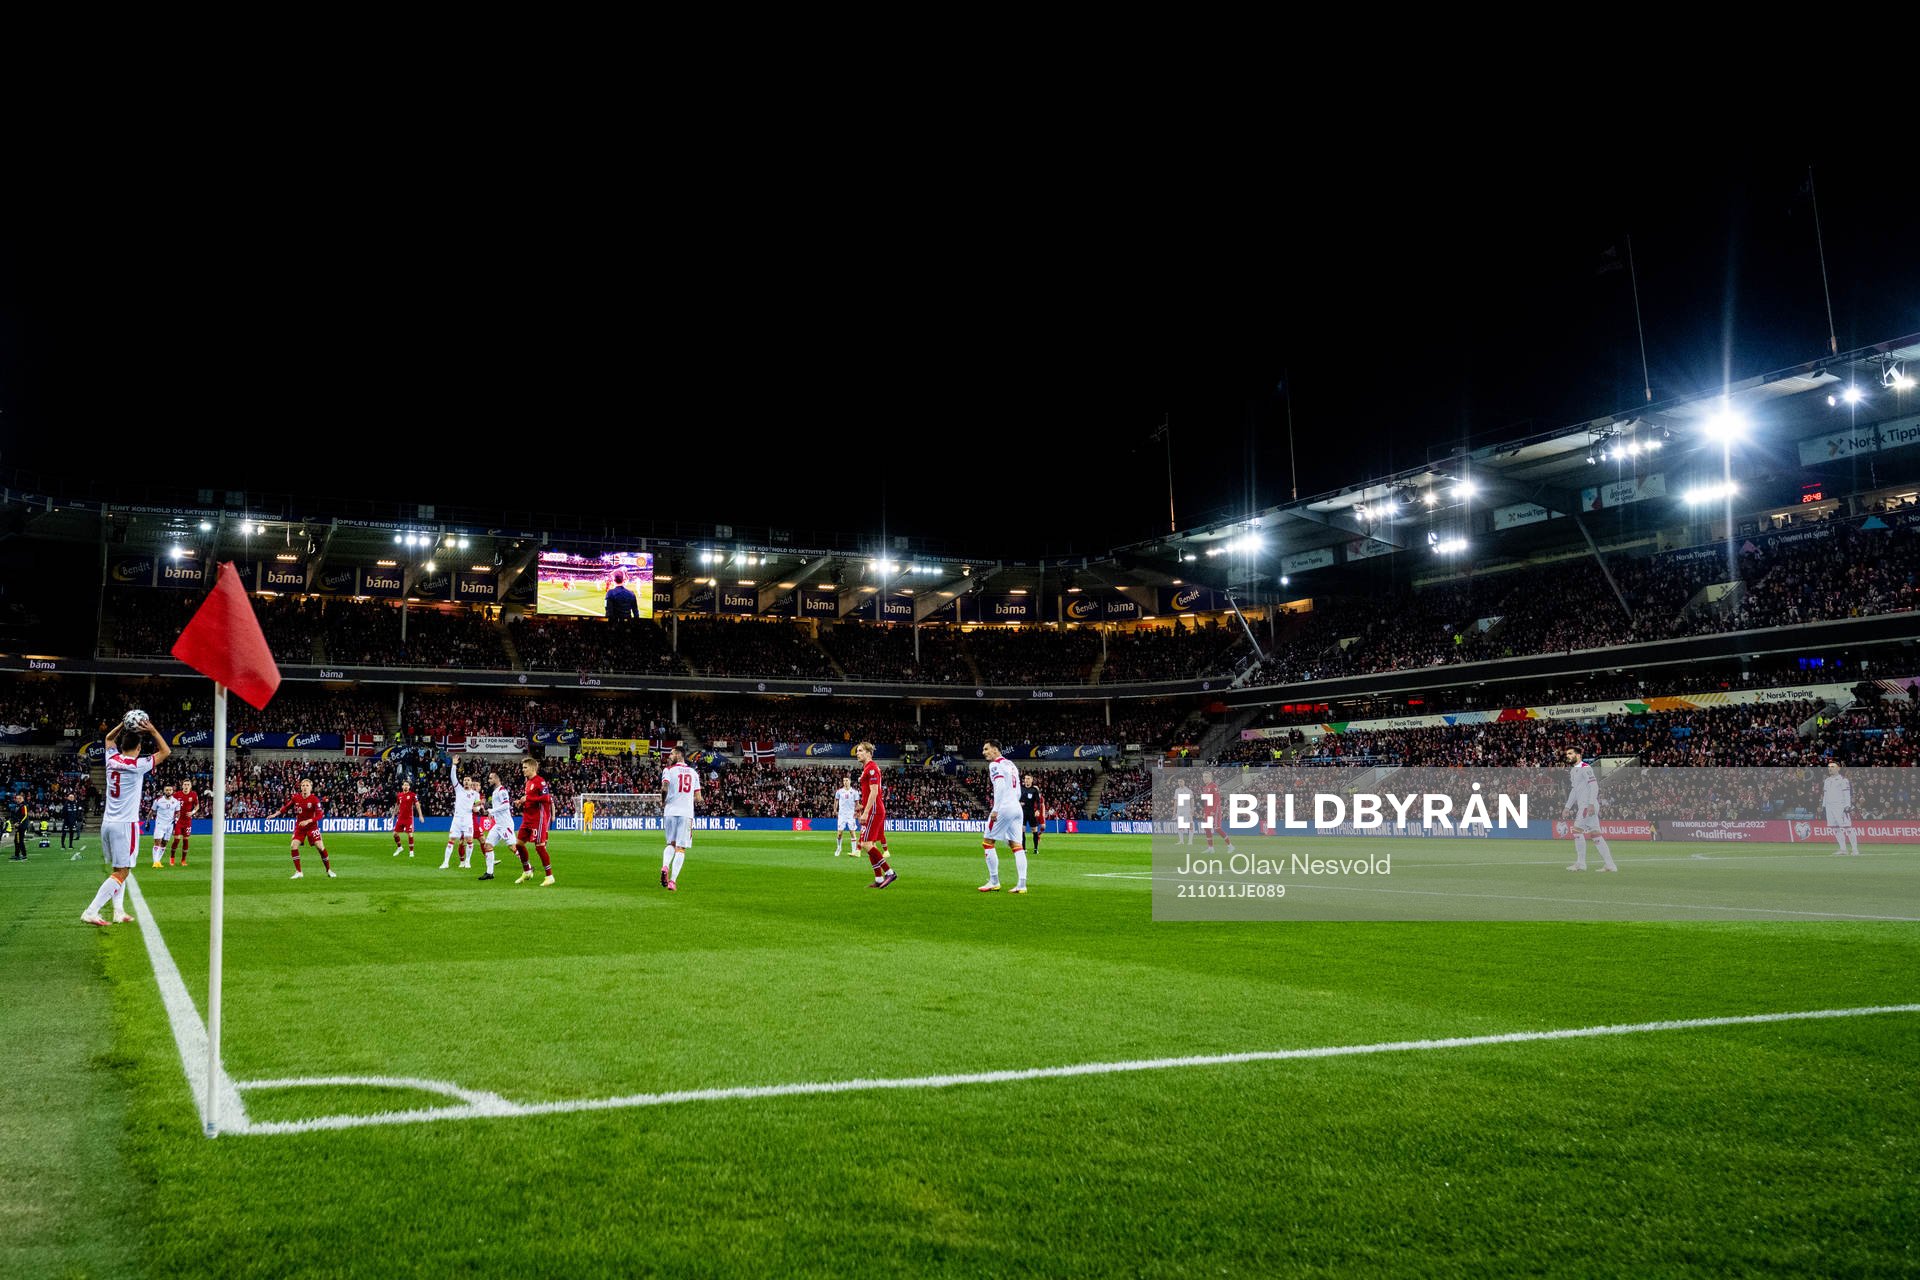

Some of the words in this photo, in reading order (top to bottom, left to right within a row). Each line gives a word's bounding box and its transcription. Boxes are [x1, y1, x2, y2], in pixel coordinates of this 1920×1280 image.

[1849, 433, 1887, 449] Norsk
[1887, 424, 1920, 442] Tippi
[1802, 492, 1822, 503] 20:48
[337, 519, 369, 527] OPPLEV
[121, 561, 152, 575] Bendit
[165, 565, 202, 579] bama
[267, 571, 304, 584] bama
[366, 575, 401, 589] bama
[461, 581, 494, 594] bama
[654, 592, 670, 602] ma
[724, 594, 754, 607] bama
[1178, 589, 1201, 605] Bendit
[806, 598, 835, 611] bama
[884, 602, 912, 614] bama
[995, 603, 1026, 614] bama
[1075, 600, 1099, 614] Bendit
[1107, 601, 1135, 613] bama
[30, 660, 55, 669] bama
[320, 669, 343, 678] bama
[813, 685, 832, 693] bama
[1032, 690, 1053, 698] bama
[1766, 691, 1786, 699] Norsk
[1787, 689, 1813, 699] Tipping
[182, 731, 208, 745] Bendit
[240, 732, 264, 745] Bendit
[296, 733, 321, 746] Bendit
[89, 746, 105, 757] Ben
[813, 743, 833, 755] Bendit
[1037, 745, 1059, 757] Bendit
[1081, 745, 1103, 757] Bendit
[110, 771, 121, 798] 3
[678, 774, 692, 793] 19
[264, 819, 295, 832] STADIO
[323, 818, 365, 831] OKTOBER
[371, 819, 382, 831] KL.
[556, 818, 609, 830] BILLEISER
[611, 818, 643, 830] VOKSNE
[645, 818, 659, 830] KR.
[692, 817, 707, 830] ARN
[710, 818, 723, 830] KR.
[724, 818, 741, 831] 50,-
[895, 819, 928, 832] BILLETTER
[939, 819, 988, 832] TICKETMAST
[1111, 821, 1131, 833] ULLEVAAL
[1133, 821, 1153, 834] STADION
[1609, 825, 1650, 835] QUALIFIERS
[1695, 829, 1743, 839] Qualifiers
